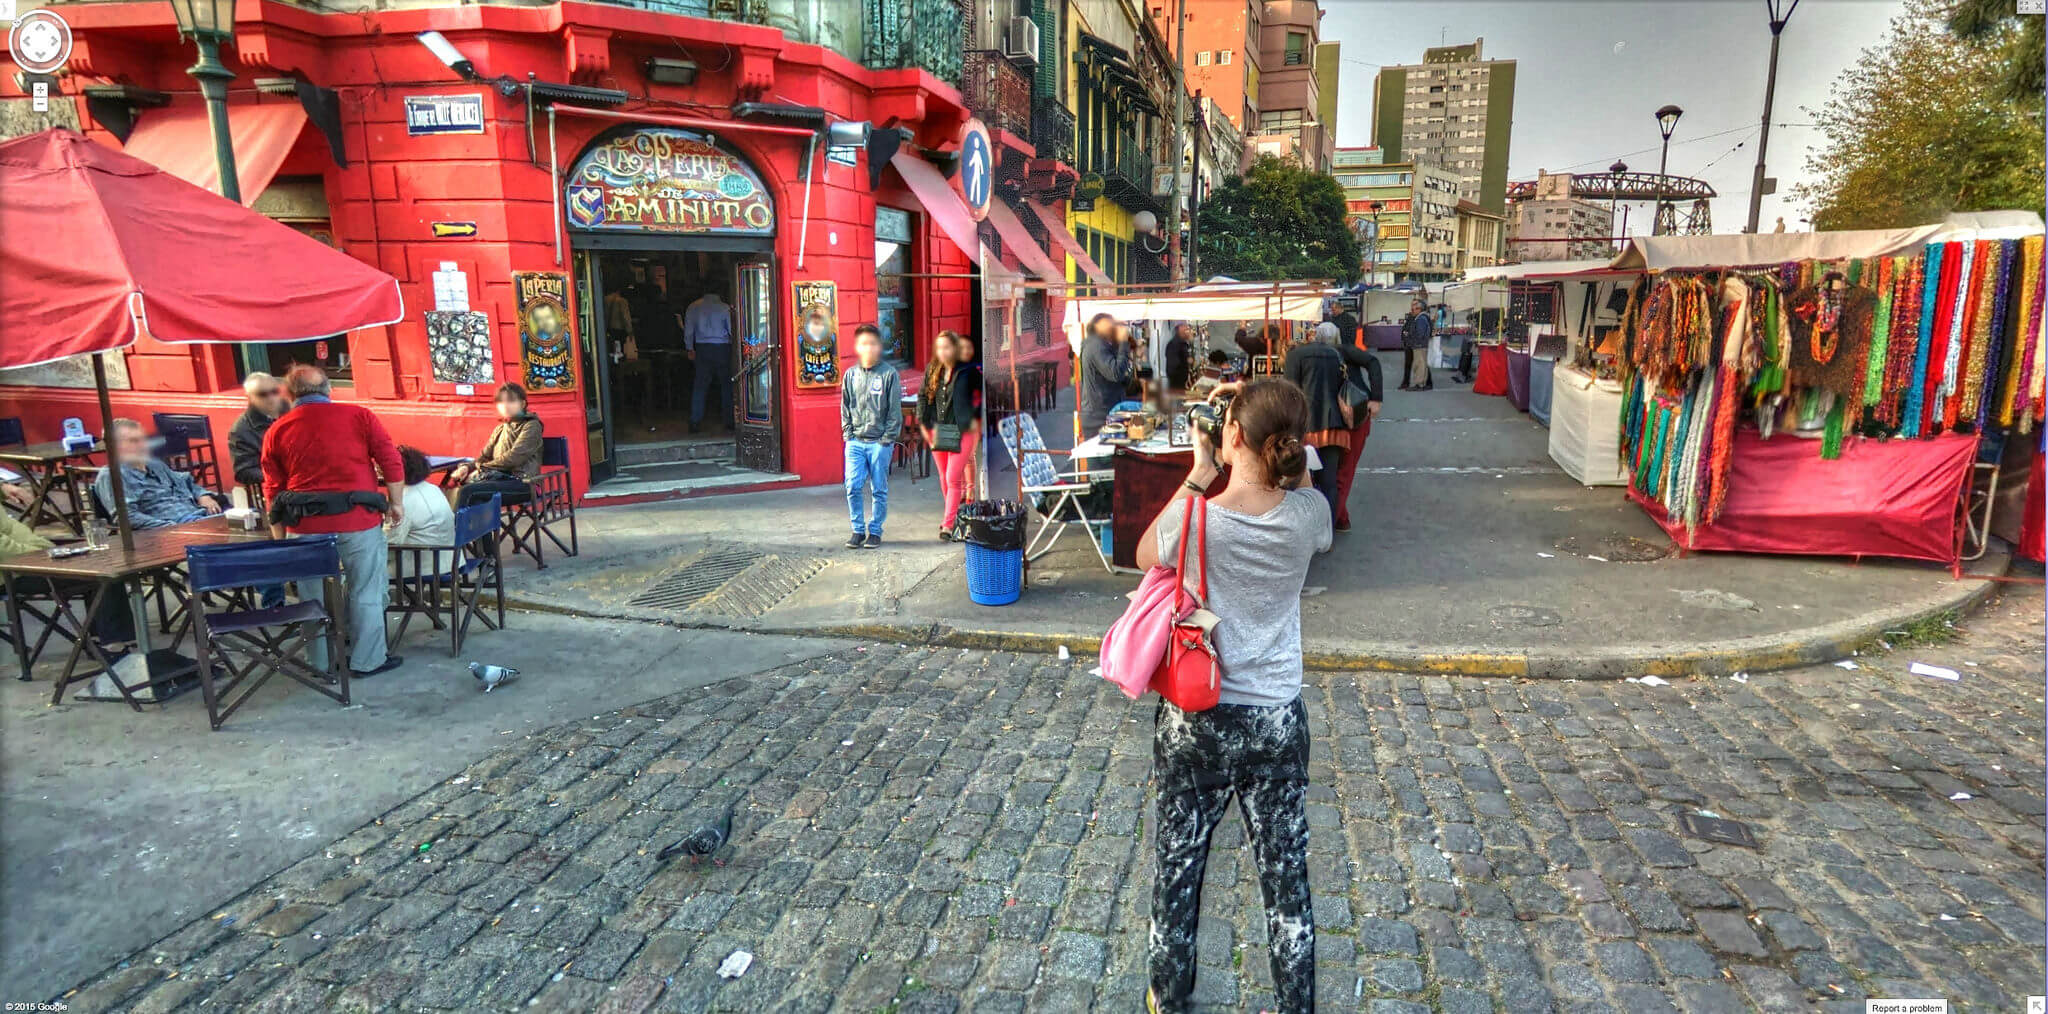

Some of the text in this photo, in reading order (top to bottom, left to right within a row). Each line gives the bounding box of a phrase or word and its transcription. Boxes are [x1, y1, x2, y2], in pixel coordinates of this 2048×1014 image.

[583, 144, 644, 182] LA
[658, 188, 684, 199] DE
[571, 187, 773, 229] CAMINITO
[521, 277, 563, 299] LA PERLA
[800, 287, 809, 307] LA
